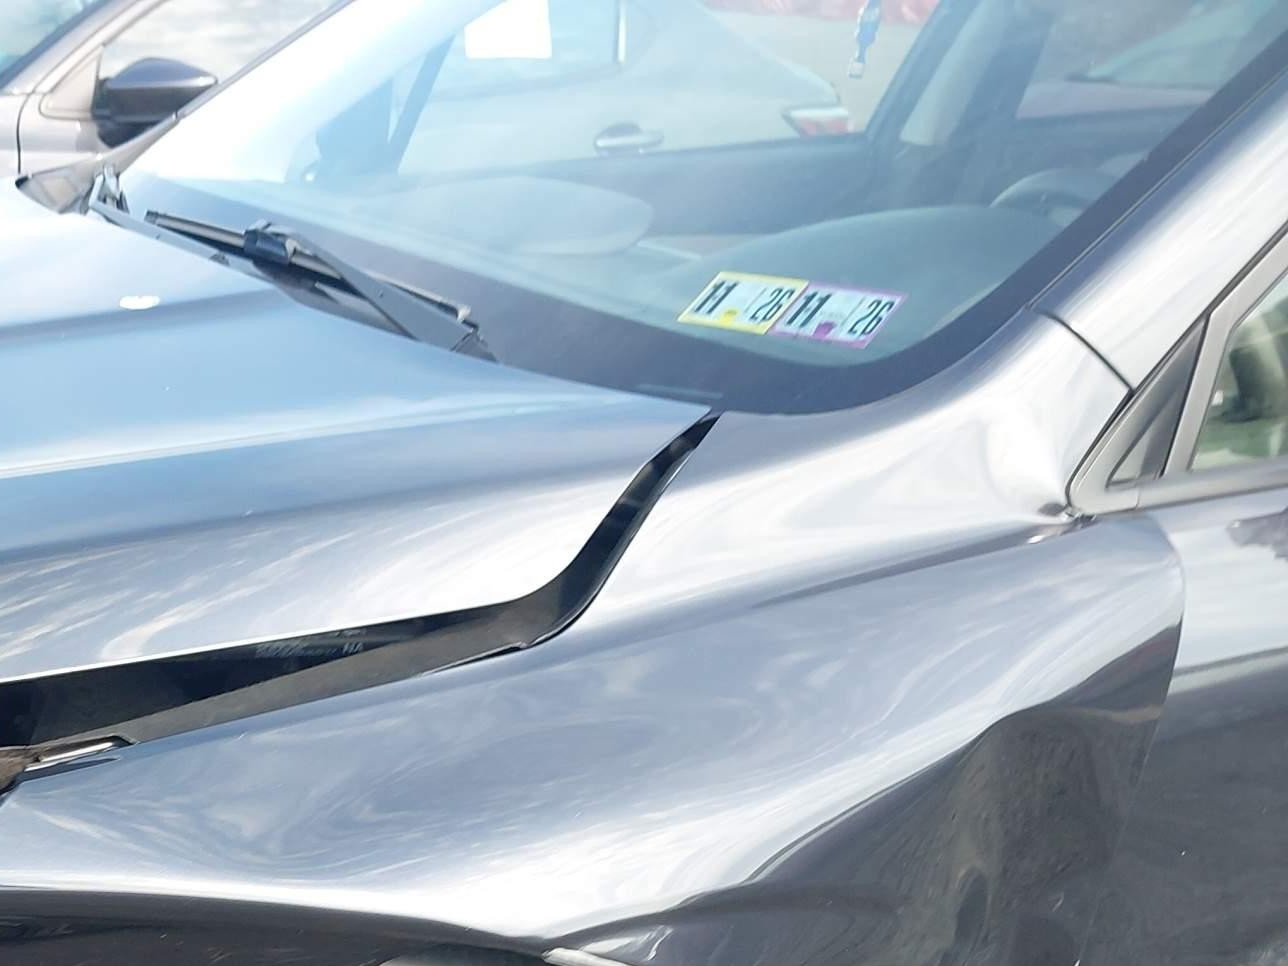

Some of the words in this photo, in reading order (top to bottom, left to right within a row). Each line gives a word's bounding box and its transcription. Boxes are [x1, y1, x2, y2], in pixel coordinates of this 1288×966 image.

[695, 280, 739, 315] 11
[749, 286, 795, 323] 26
[786, 291, 833, 328] 11
[847, 298, 895, 336] 26
